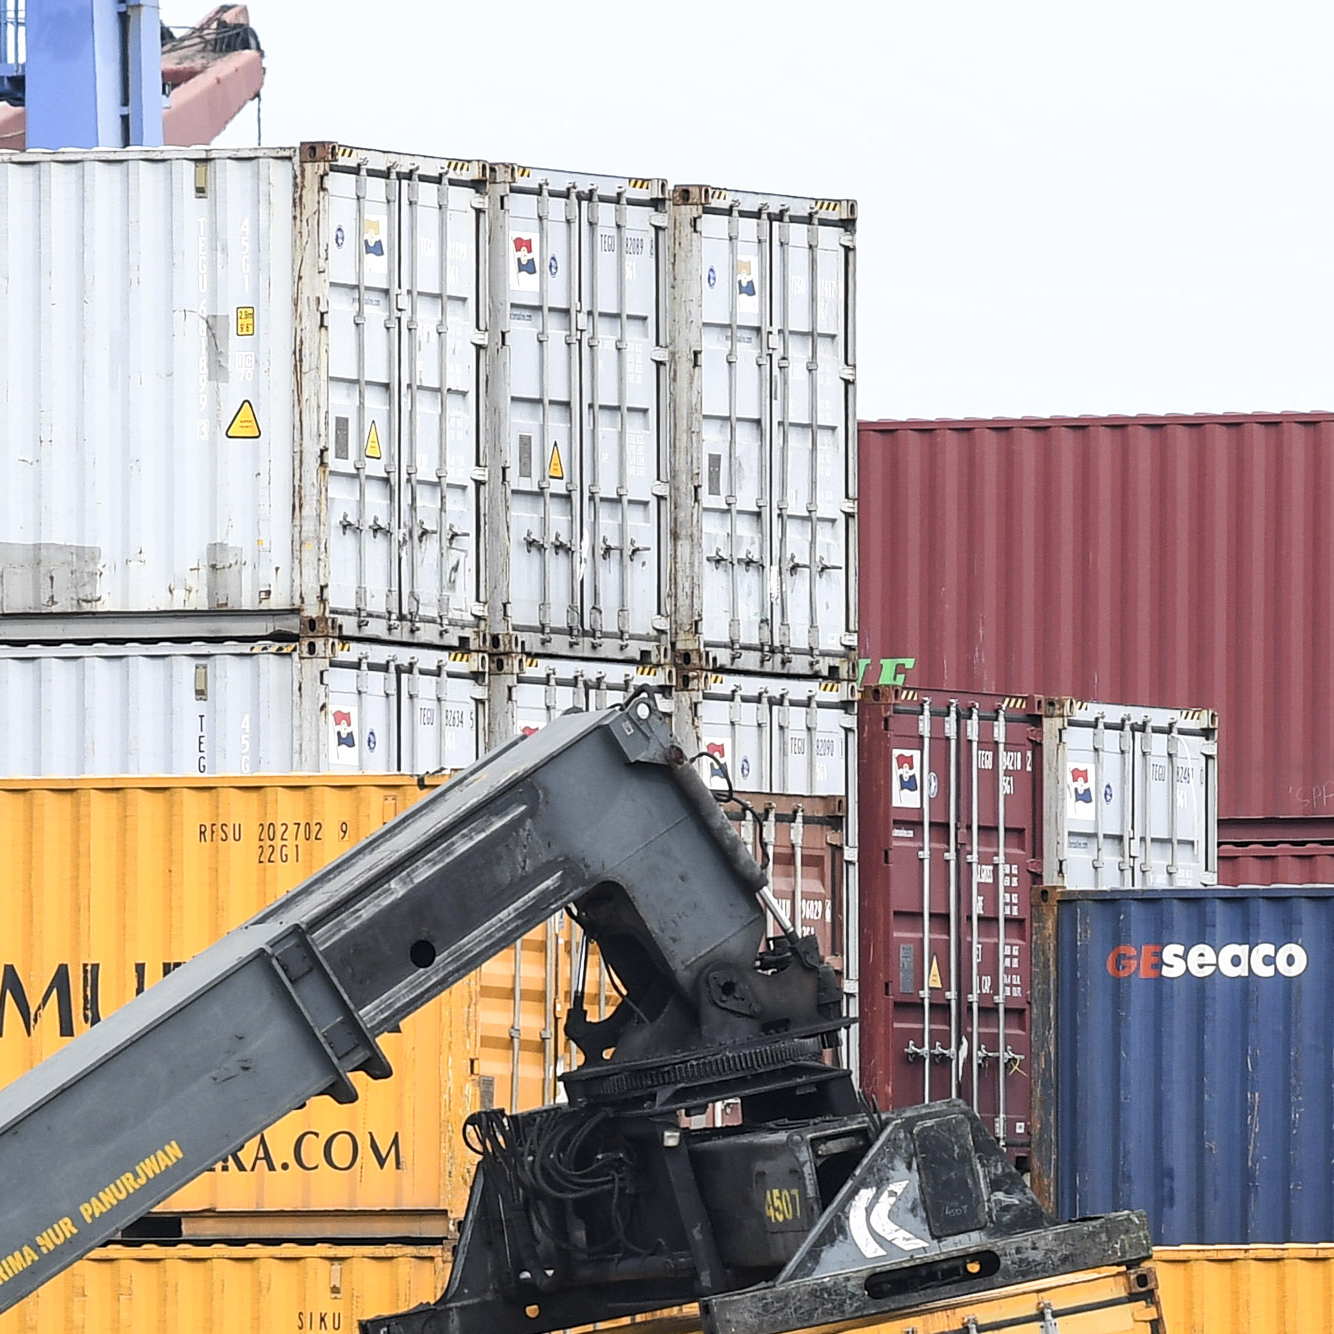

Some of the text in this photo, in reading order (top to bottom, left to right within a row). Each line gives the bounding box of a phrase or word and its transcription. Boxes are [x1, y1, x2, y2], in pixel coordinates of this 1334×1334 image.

[600, 234, 644, 256] TEGU 82089
[238, 371, 253, 381] 70
[419, 706, 464, 728] TEGU 82634
[790, 736, 805, 756] TEGU
[978, 750, 993, 770] TEGU
[1151, 763, 1166, 782] TEGU
[199, 823, 349, 842] RFSU 202702 9
[258, 845, 300, 863] 22G1
[1106, 942, 1308, 979] GEseaco
[34, 1216, 79, 1255] NUR
[79, 1139, 185, 1224] PANURJWAN
[766, 1188, 801, 1223] 4507
[297, 1311, 342, 1331] SIKU
